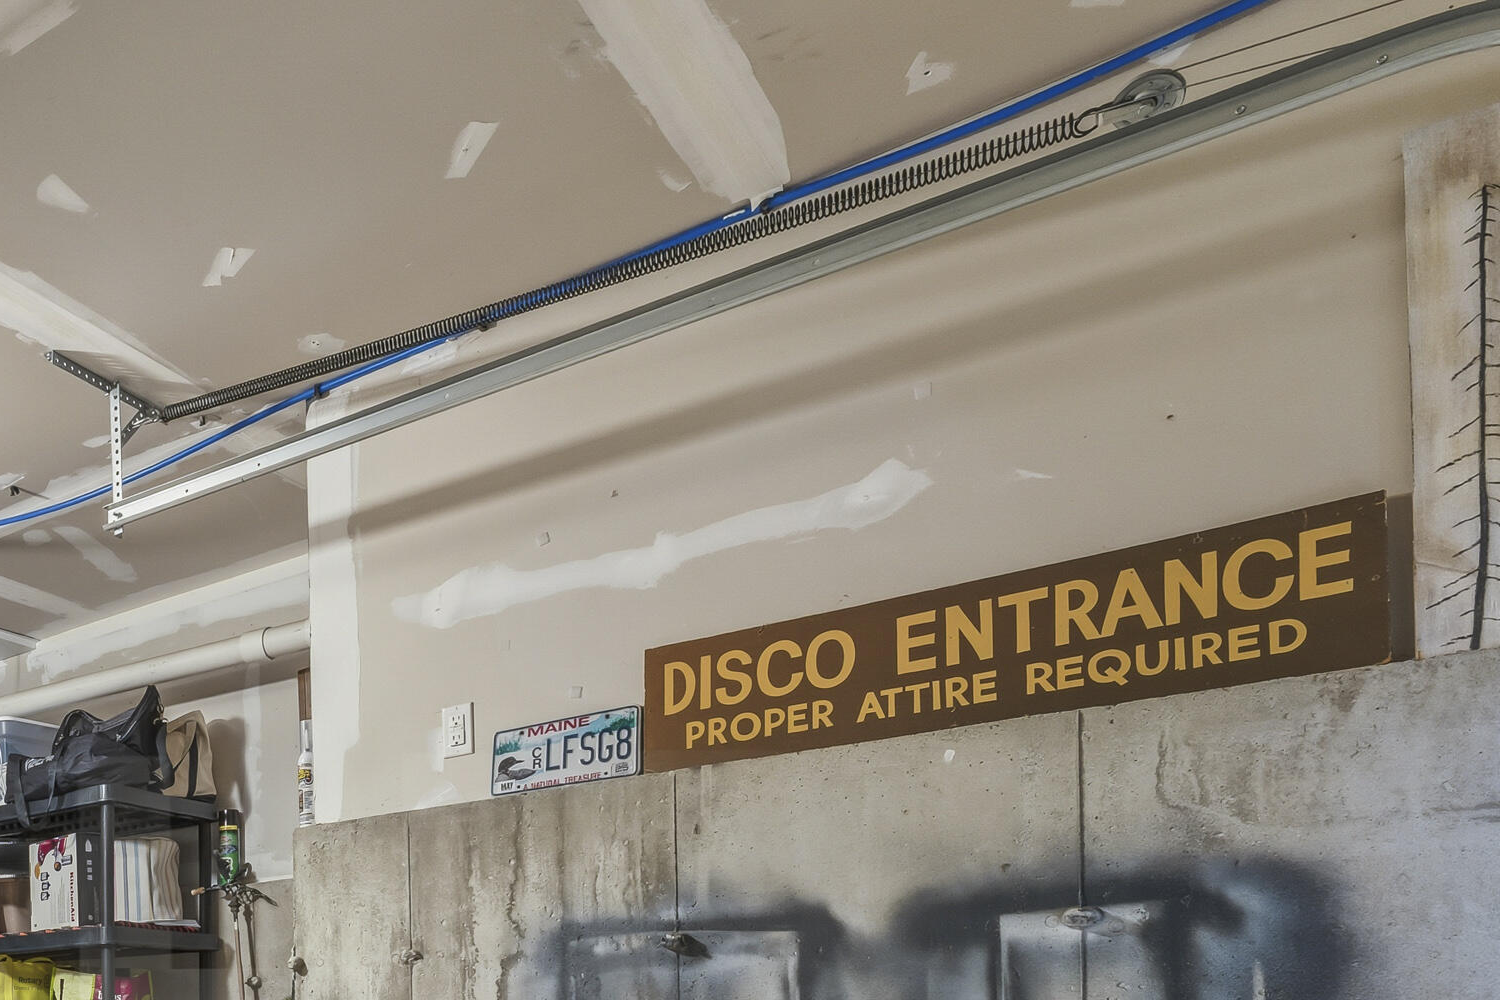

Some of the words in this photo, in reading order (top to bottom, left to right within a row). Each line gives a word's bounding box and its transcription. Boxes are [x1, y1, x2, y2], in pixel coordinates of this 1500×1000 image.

[663, 629, 856, 716] DISCO
[896, 520, 1354, 676] ENTRANCE
[685, 699, 834, 750] PROPER
[856, 669, 997, 724] ATTIRE
[1026, 618, 1308, 695] REQUIRED
[527, 716, 590, 738] MAINE
[545, 726, 632, 771] LFSG8
[531, 779, 560, 789] NATURAL
[564, 772, 602, 784] TREASURE
